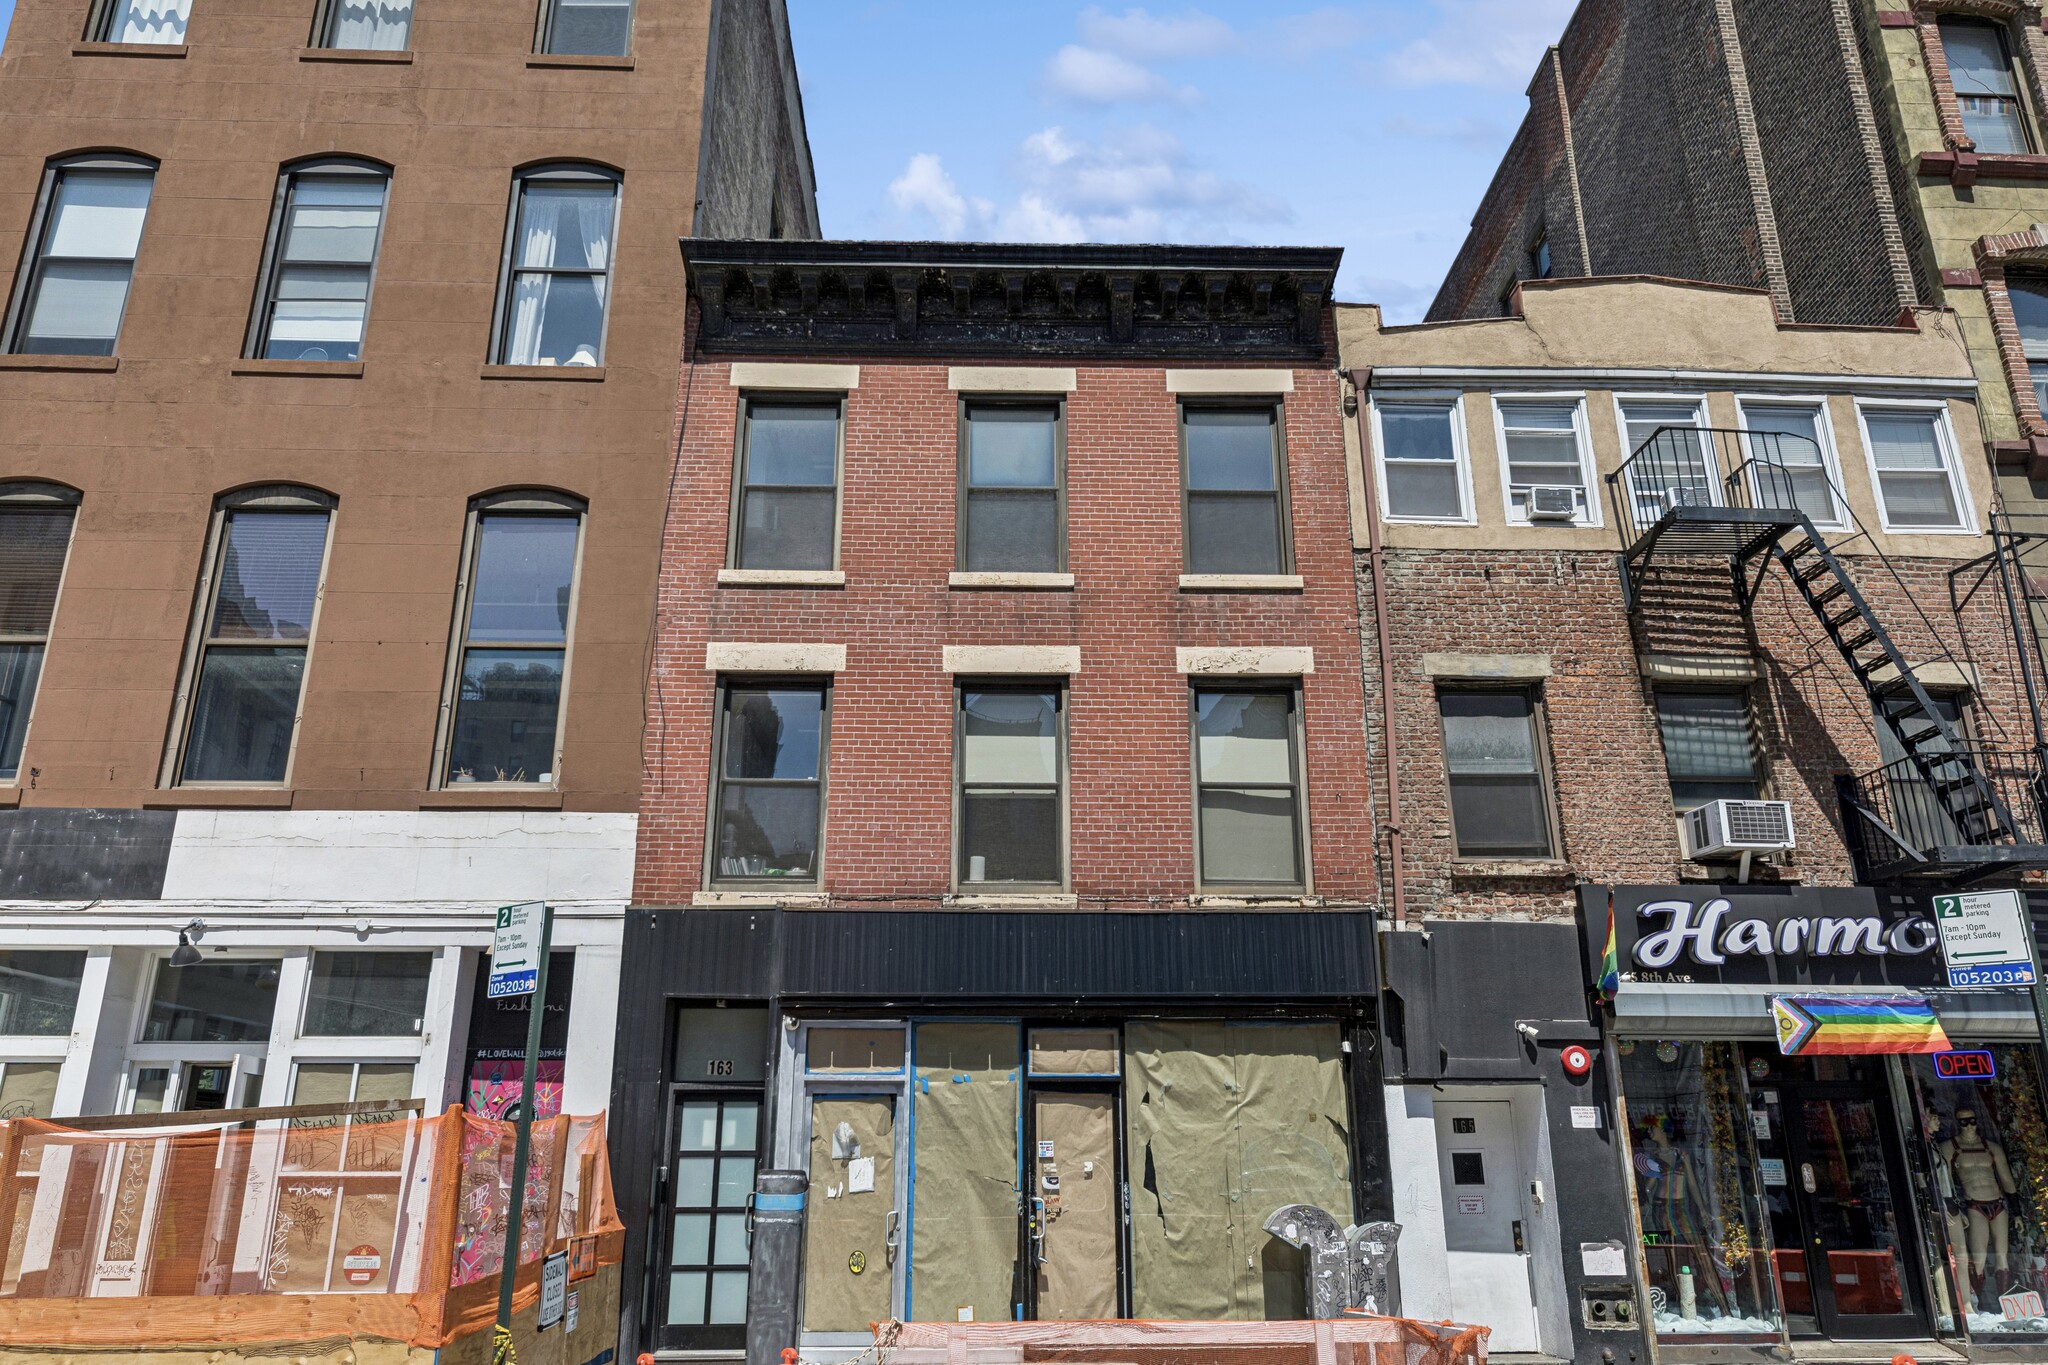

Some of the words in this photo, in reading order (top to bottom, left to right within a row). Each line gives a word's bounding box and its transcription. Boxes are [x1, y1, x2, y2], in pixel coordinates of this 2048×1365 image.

[1941, 898, 1957, 917] 2
[1964, 902, 1991, 910] metered
[500, 908, 509, 927] 2
[1965, 909, 1990, 918] parking
[512, 918, 527, 926] parking
[1943, 925, 1959, 933] 7am
[1965, 923, 1986, 932] 10pm
[510, 933, 522, 941] 10pm
[1632, 898, 1941, 967] Harmo
[1945, 932, 1972, 942] Except
[1973, 931, 2001, 940] Sunday
[496, 944, 511, 952] Except
[512, 941, 528, 950] Sunday
[1641, 971, 1663, 982] 8th
[1666, 972, 1695, 982] Ave.
[1952, 970, 2013, 985] 105203
[490, 979, 524, 995] 105203
[496, 995, 565, 1011] Fishne
[710, 1060, 733, 1075] 163
[1938, 1055, 1993, 1075] OPEN
[1454, 1120, 1475, 1133] 165
[2001, 1293, 2043, 1320] DVD
